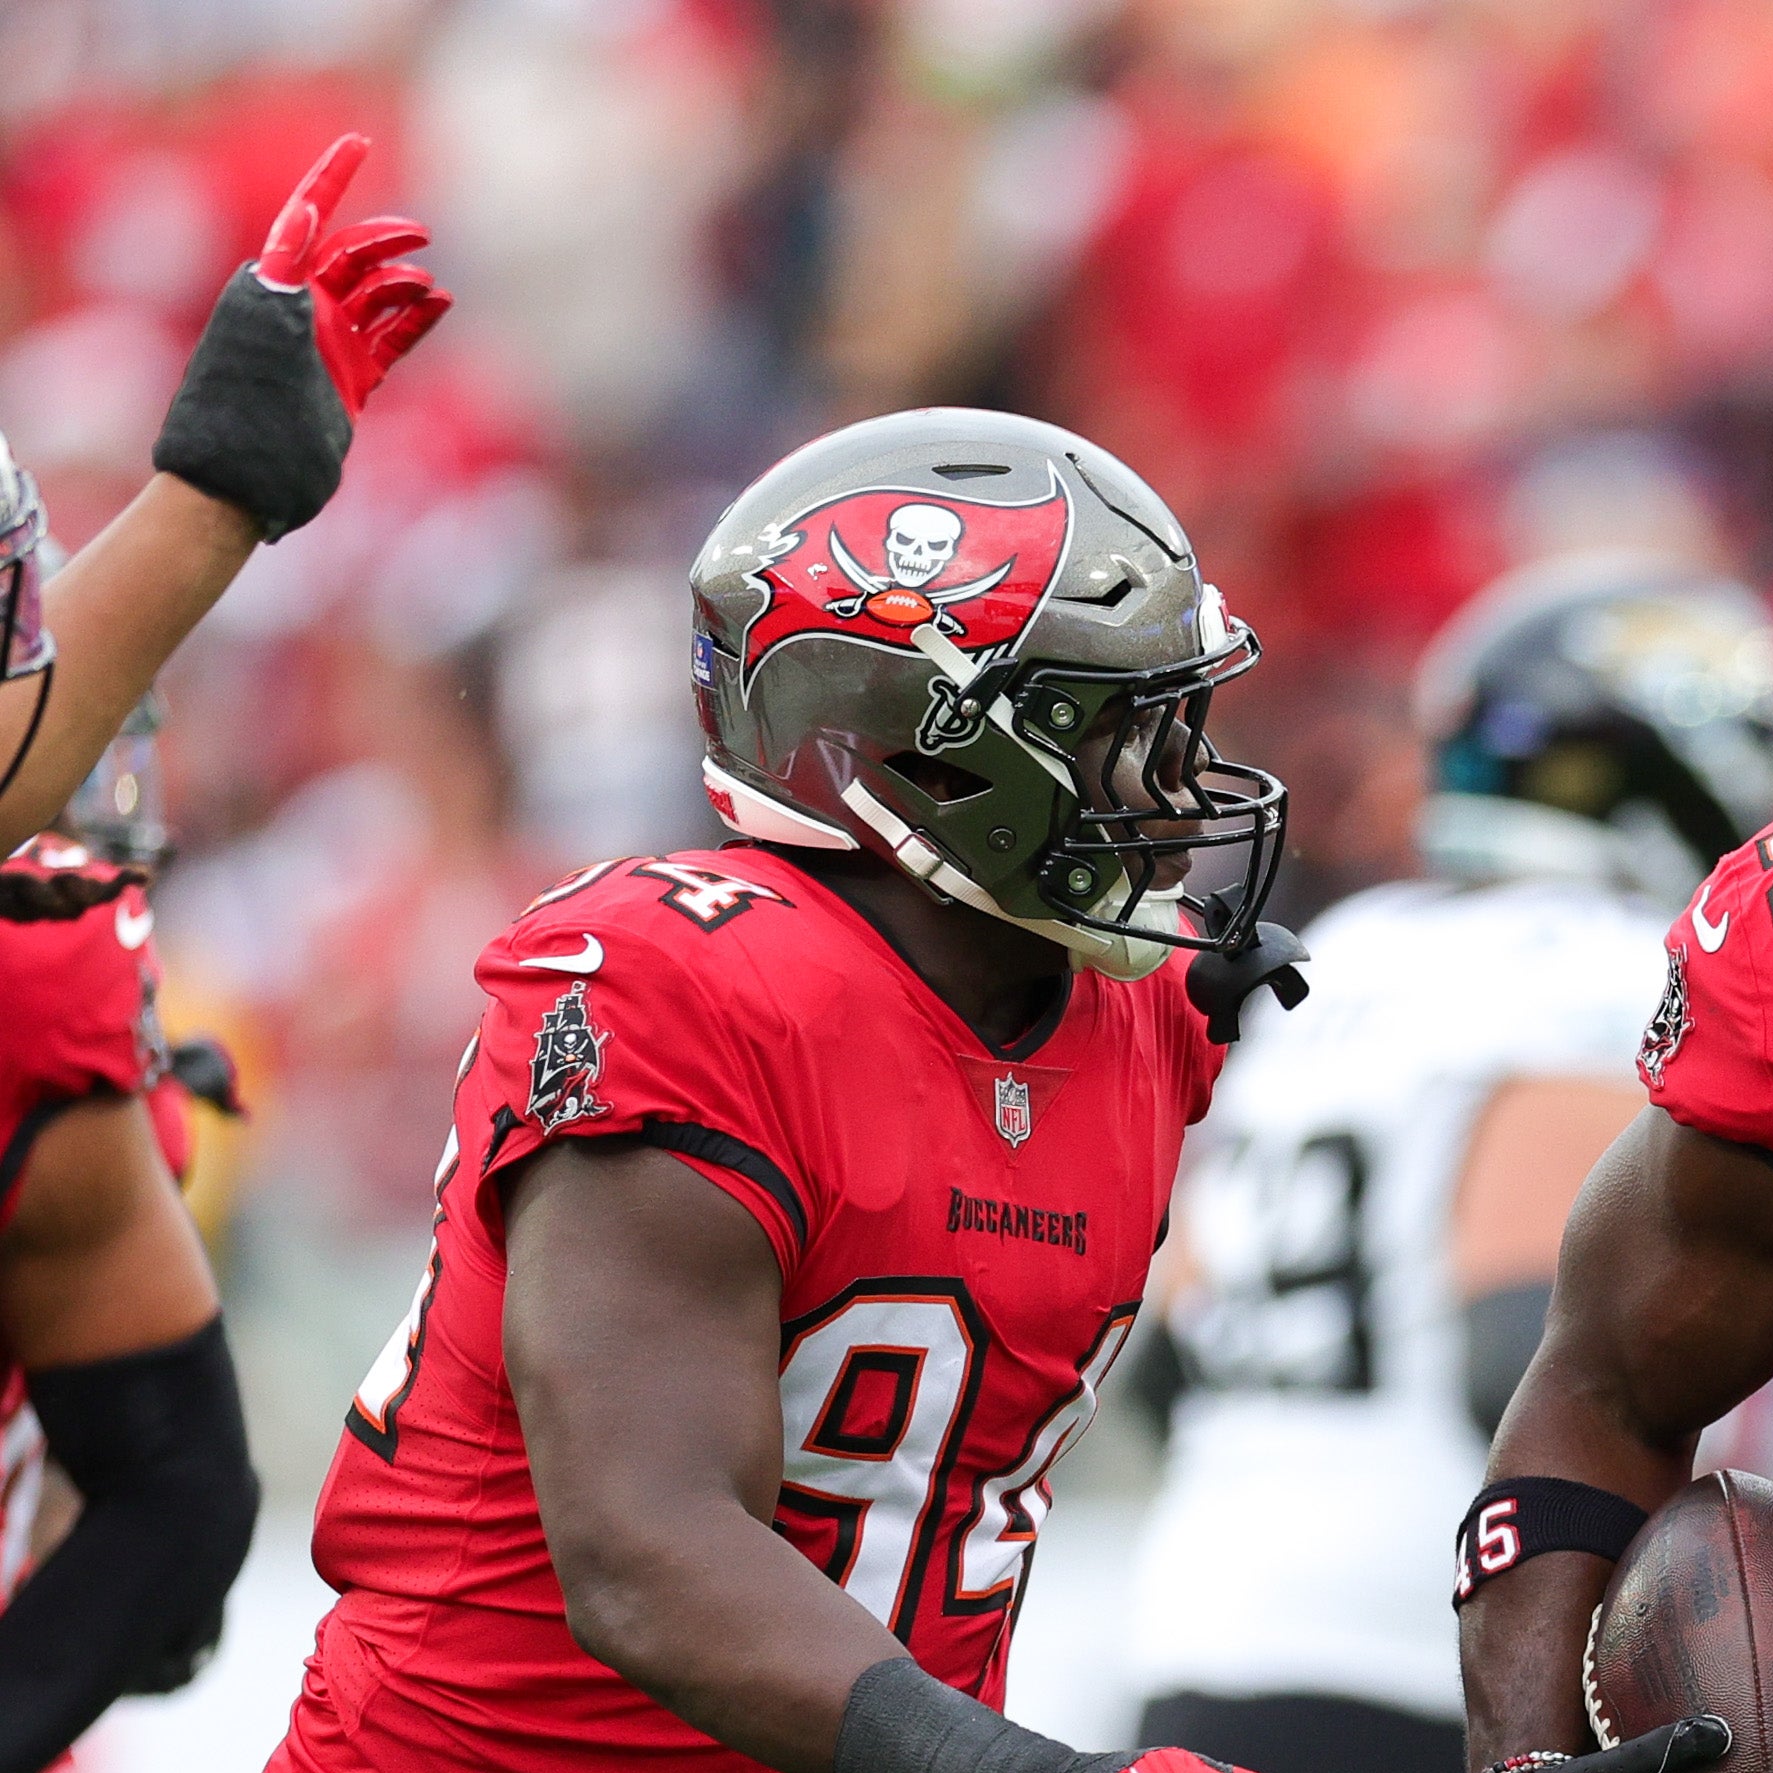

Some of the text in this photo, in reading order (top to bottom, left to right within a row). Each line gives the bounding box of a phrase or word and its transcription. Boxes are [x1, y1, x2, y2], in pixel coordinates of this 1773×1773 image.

[1003, 1107, 1026, 1134] NFL
[946, 1186, 1087, 1257] BUCCANEERS
[776, 1275, 1143, 1650] 94
[1455, 1498, 1520, 1599] 45
